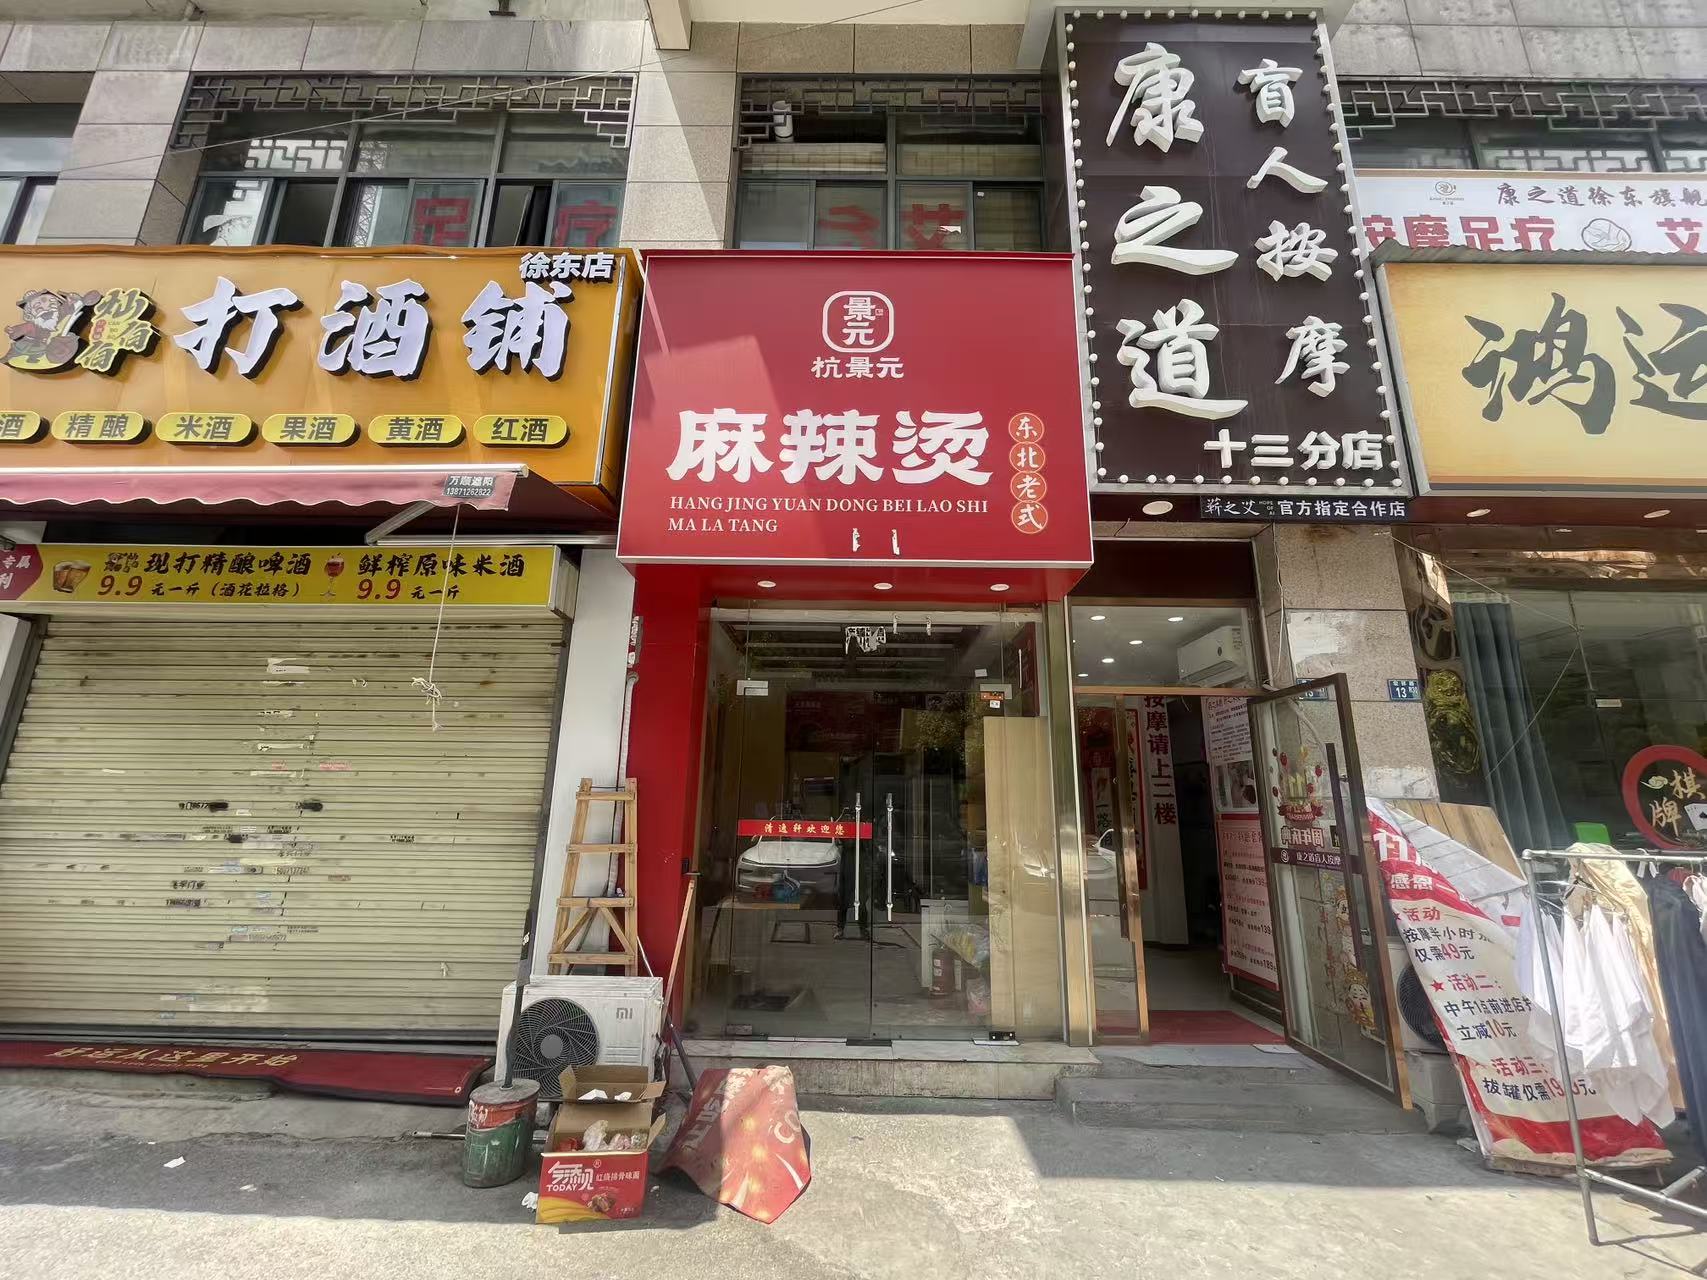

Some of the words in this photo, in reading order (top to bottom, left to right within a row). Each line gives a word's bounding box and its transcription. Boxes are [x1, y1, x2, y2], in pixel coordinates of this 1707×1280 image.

[1105, 42, 1249, 420] 康之道
[1236, 57, 1350, 398] 盲人按摩
[519, 251, 614, 280] 徐东店
[174, 276, 571, 380] 打酒铺
[842, 296, 877, 346] 景元
[811, 356, 905, 379] 杭景元
[68, 414, 128, 439] 精酿
[176, 414, 232, 441] 米酒
[280, 414, 337, 441] 果酒
[387, 415, 443, 442] 黄酒
[492, 416, 549, 443] 红酒
[666, 408, 993, 487] 麻辣烫
[1204, 429, 1385, 470] 十三分店
[1014, 415, 1043, 530] 东北老式
[670, 495, 723, 512] HANG
[725, 496, 768, 513] JING
[771, 497, 823, 512] YUAN
[825, 497, 878, 513] DONG
[882, 498, 912, 513] BEI
[916, 499, 953, 513] LAO
[956, 500, 989, 513] SHI
[1277, 500, 1406, 517] 官方指定合作店
[668, 516, 696, 532] MA
[701, 517, 724, 532] LA
[728, 518, 778, 533] TANG
[144, 551, 312, 576] 现打精酿啤酒
[358, 553, 525, 577] 鲜榨原味米酒
[97, 575, 144, 597] 9.9
[150, 582, 200, 597] 元一斤
[357, 578, 402, 601] 9.9
[410, 584, 463, 600] 元一斤
[546, 1183, 578, 1192] TODAY
